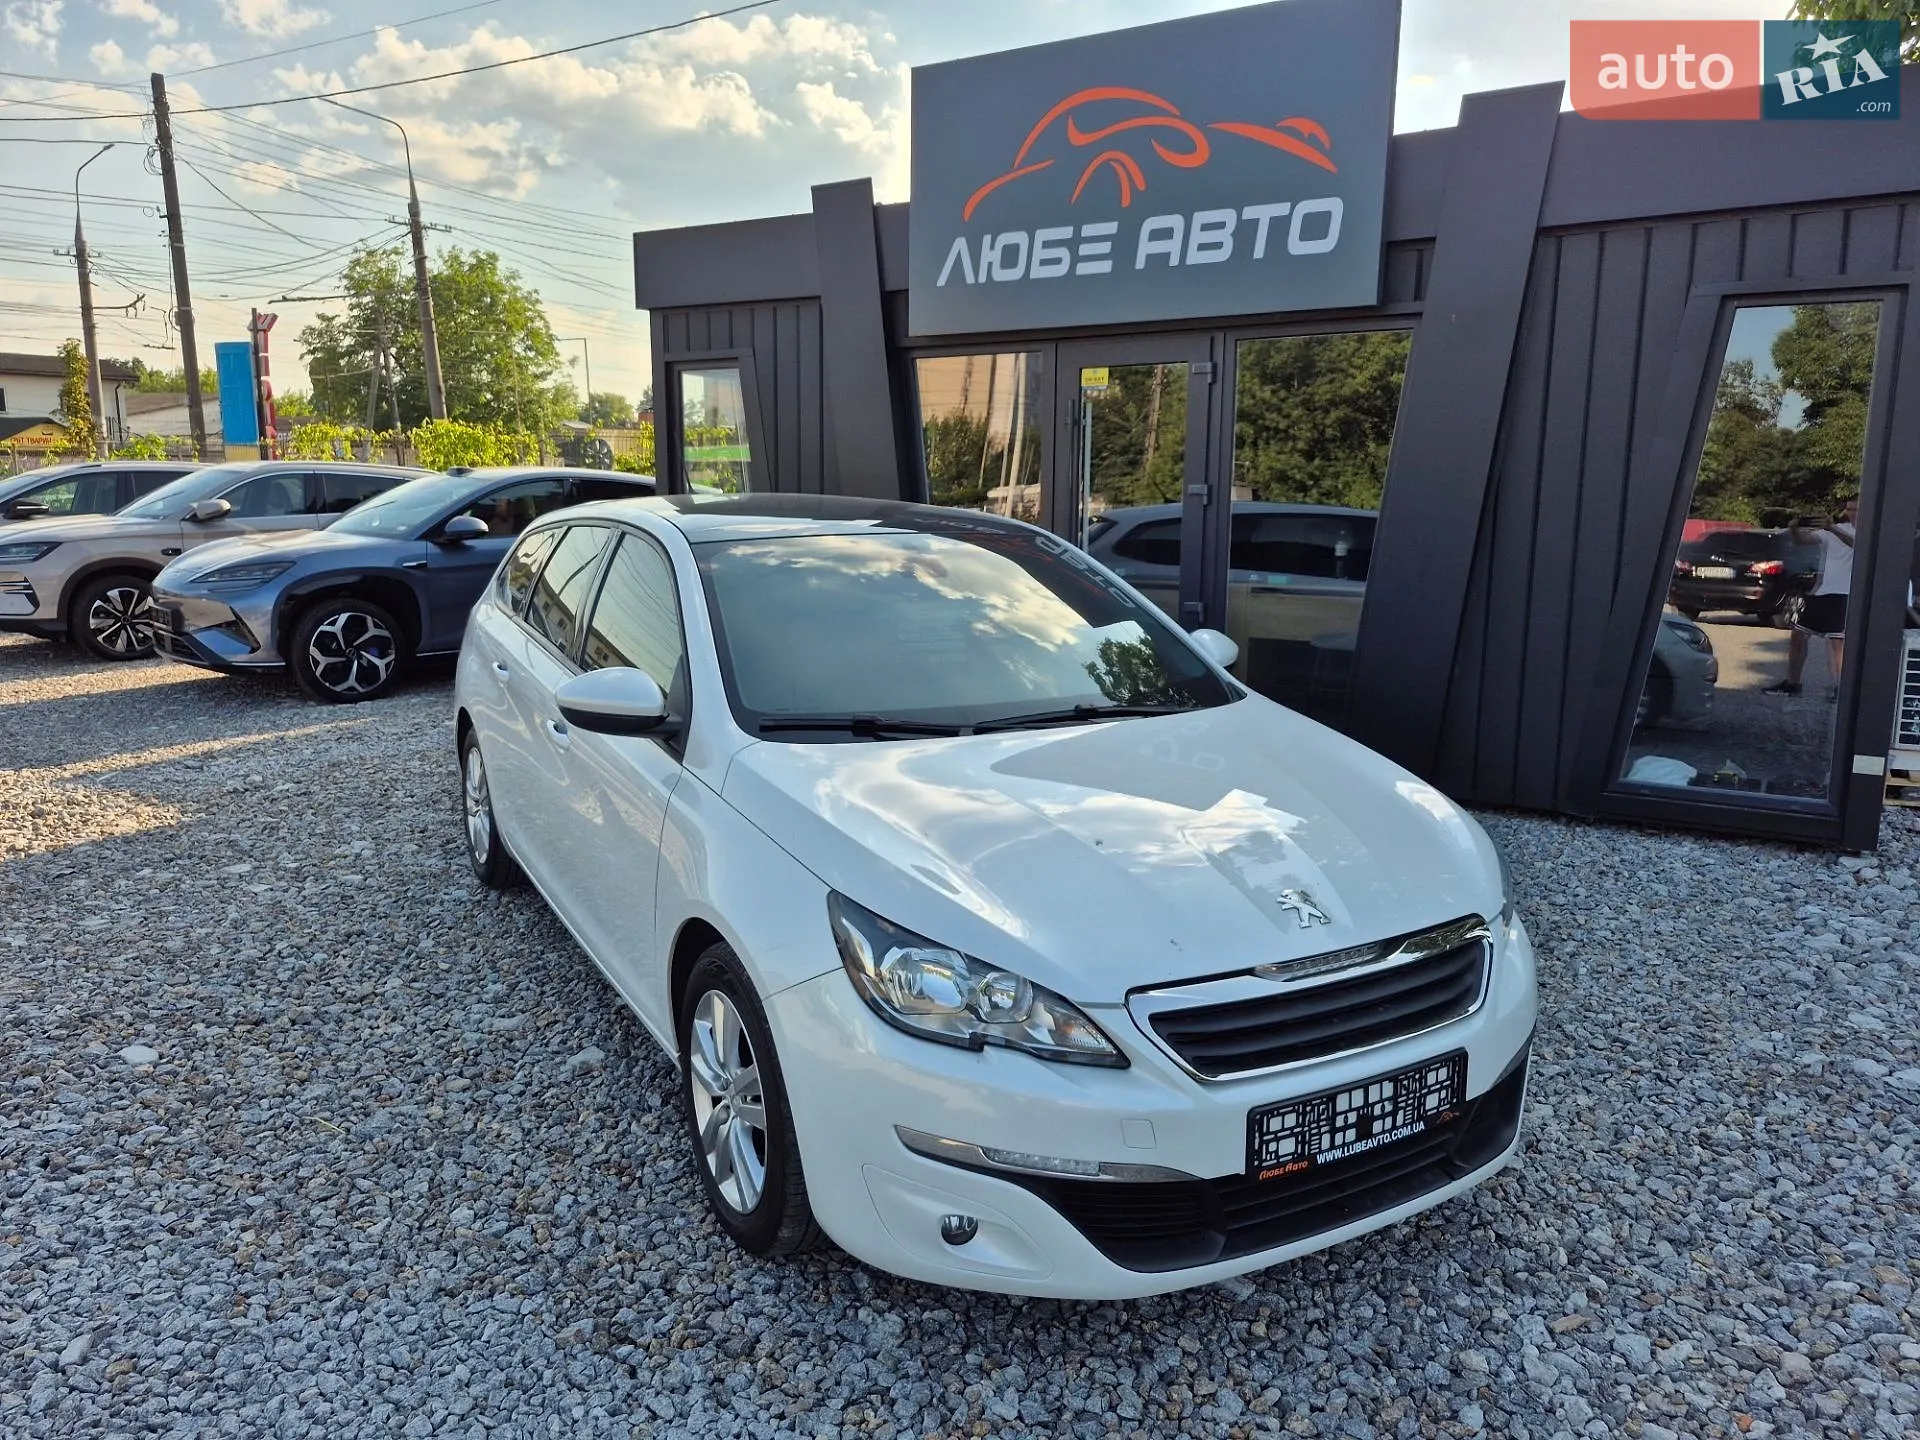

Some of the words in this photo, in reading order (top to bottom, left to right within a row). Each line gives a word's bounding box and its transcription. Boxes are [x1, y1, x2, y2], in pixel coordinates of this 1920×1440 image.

[936, 221, 1119, 287] ЛЮБЕ
[1134, 197, 1344, 271] АВТО
[1316, 1121, 1425, 1165] WWW.LUBEAVTO.COM.UA
